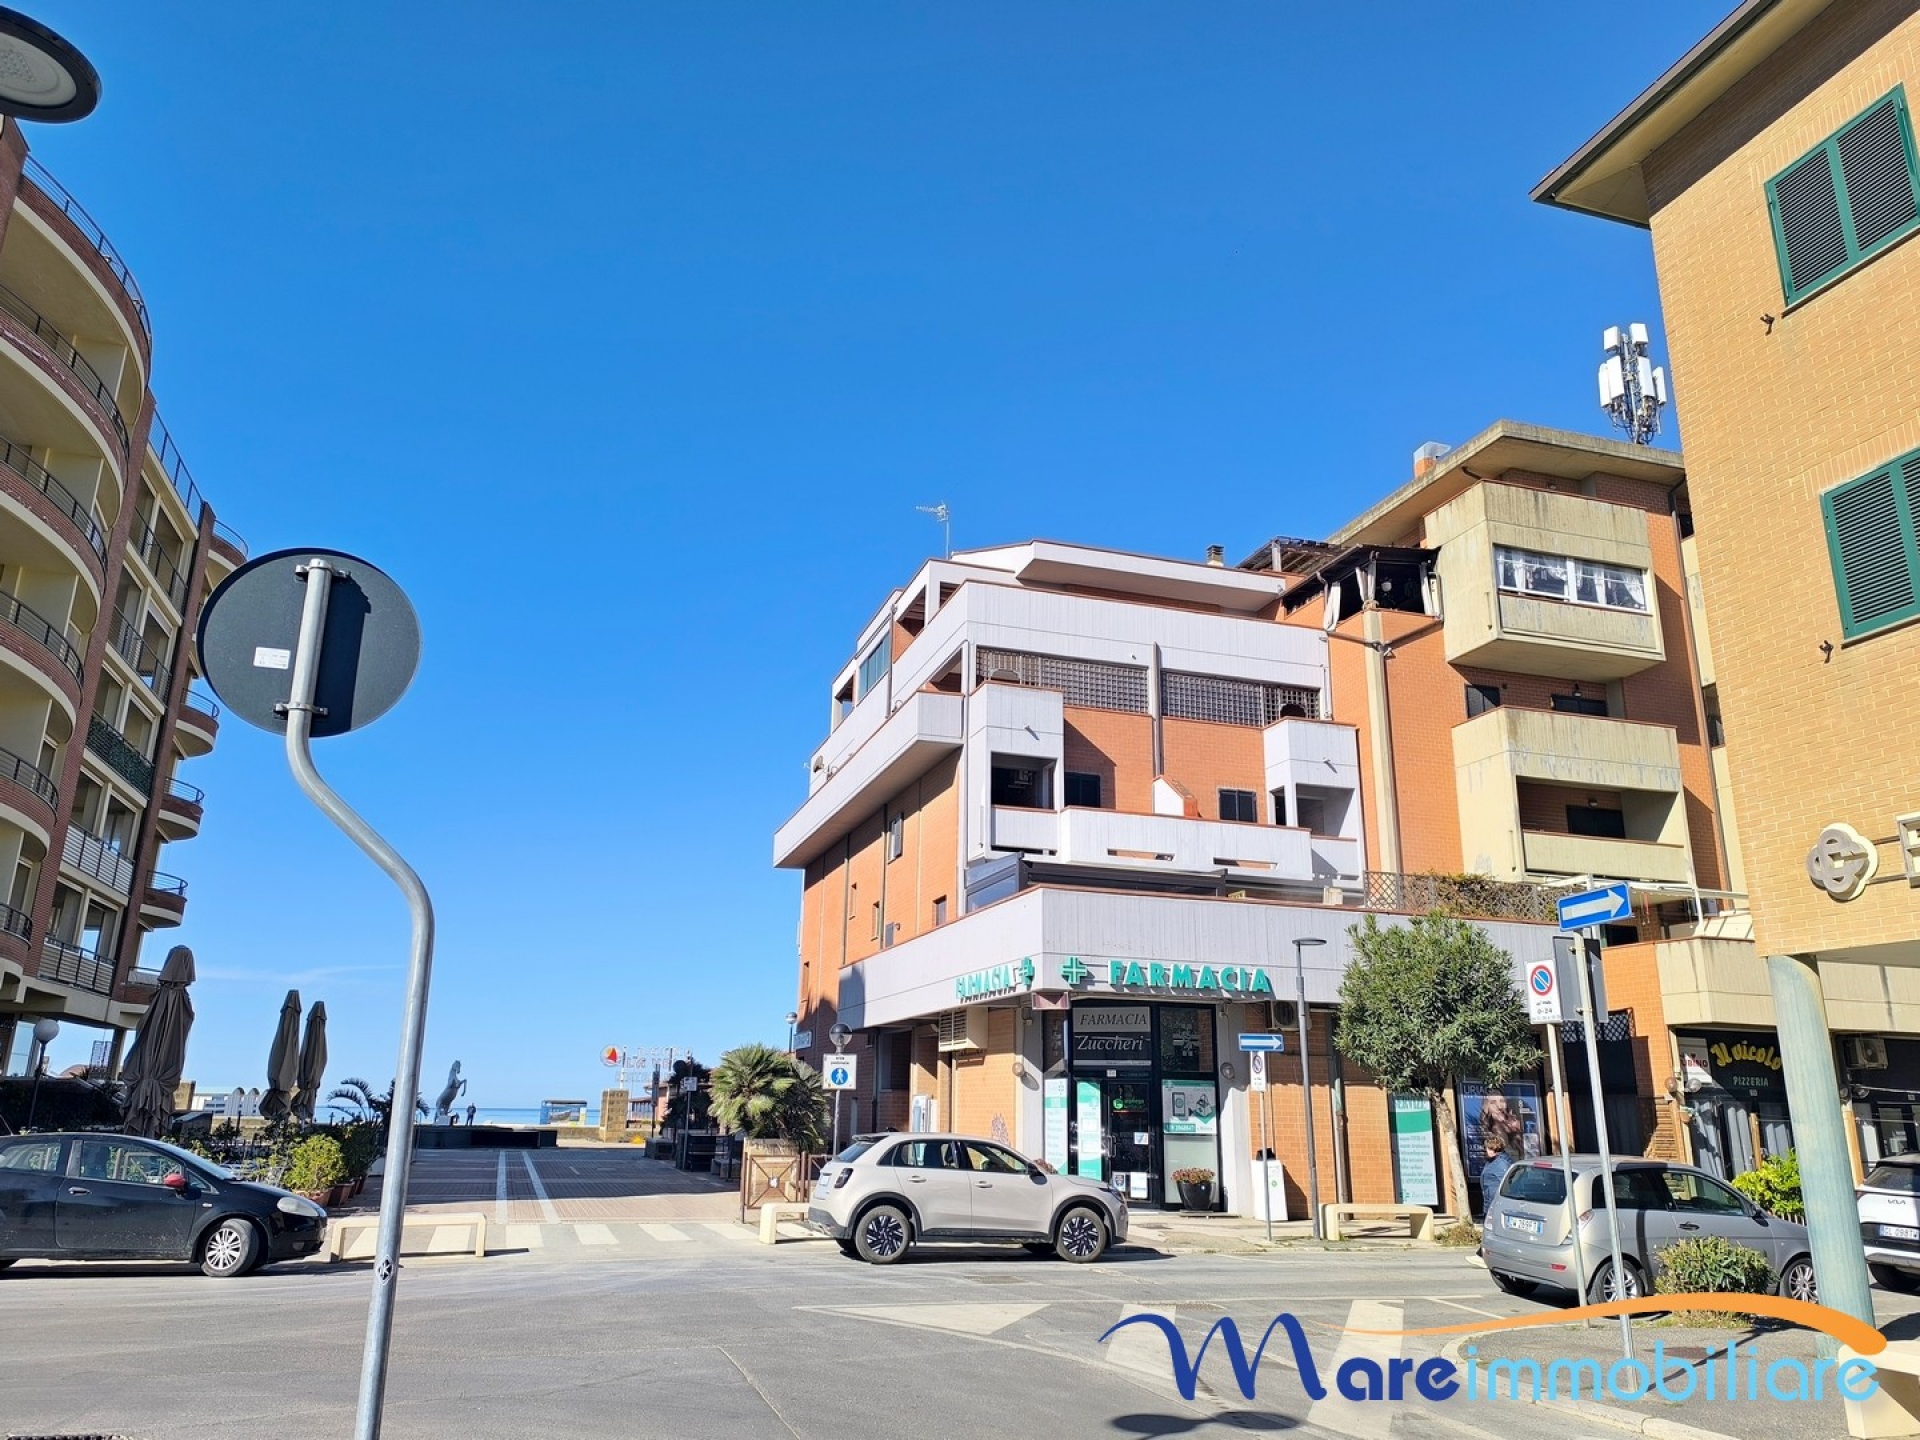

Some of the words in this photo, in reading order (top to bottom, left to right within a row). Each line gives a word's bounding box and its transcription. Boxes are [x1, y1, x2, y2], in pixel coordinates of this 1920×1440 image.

[955, 964, 1011, 999] FARMACIA
[1108, 959, 1271, 993] FARMACIA
[1079, 1013, 1148, 1026] FARMACIA
[1074, 1034, 1145, 1051] Zuccheri
[1732, 1075, 1769, 1087] PIZZERIA
